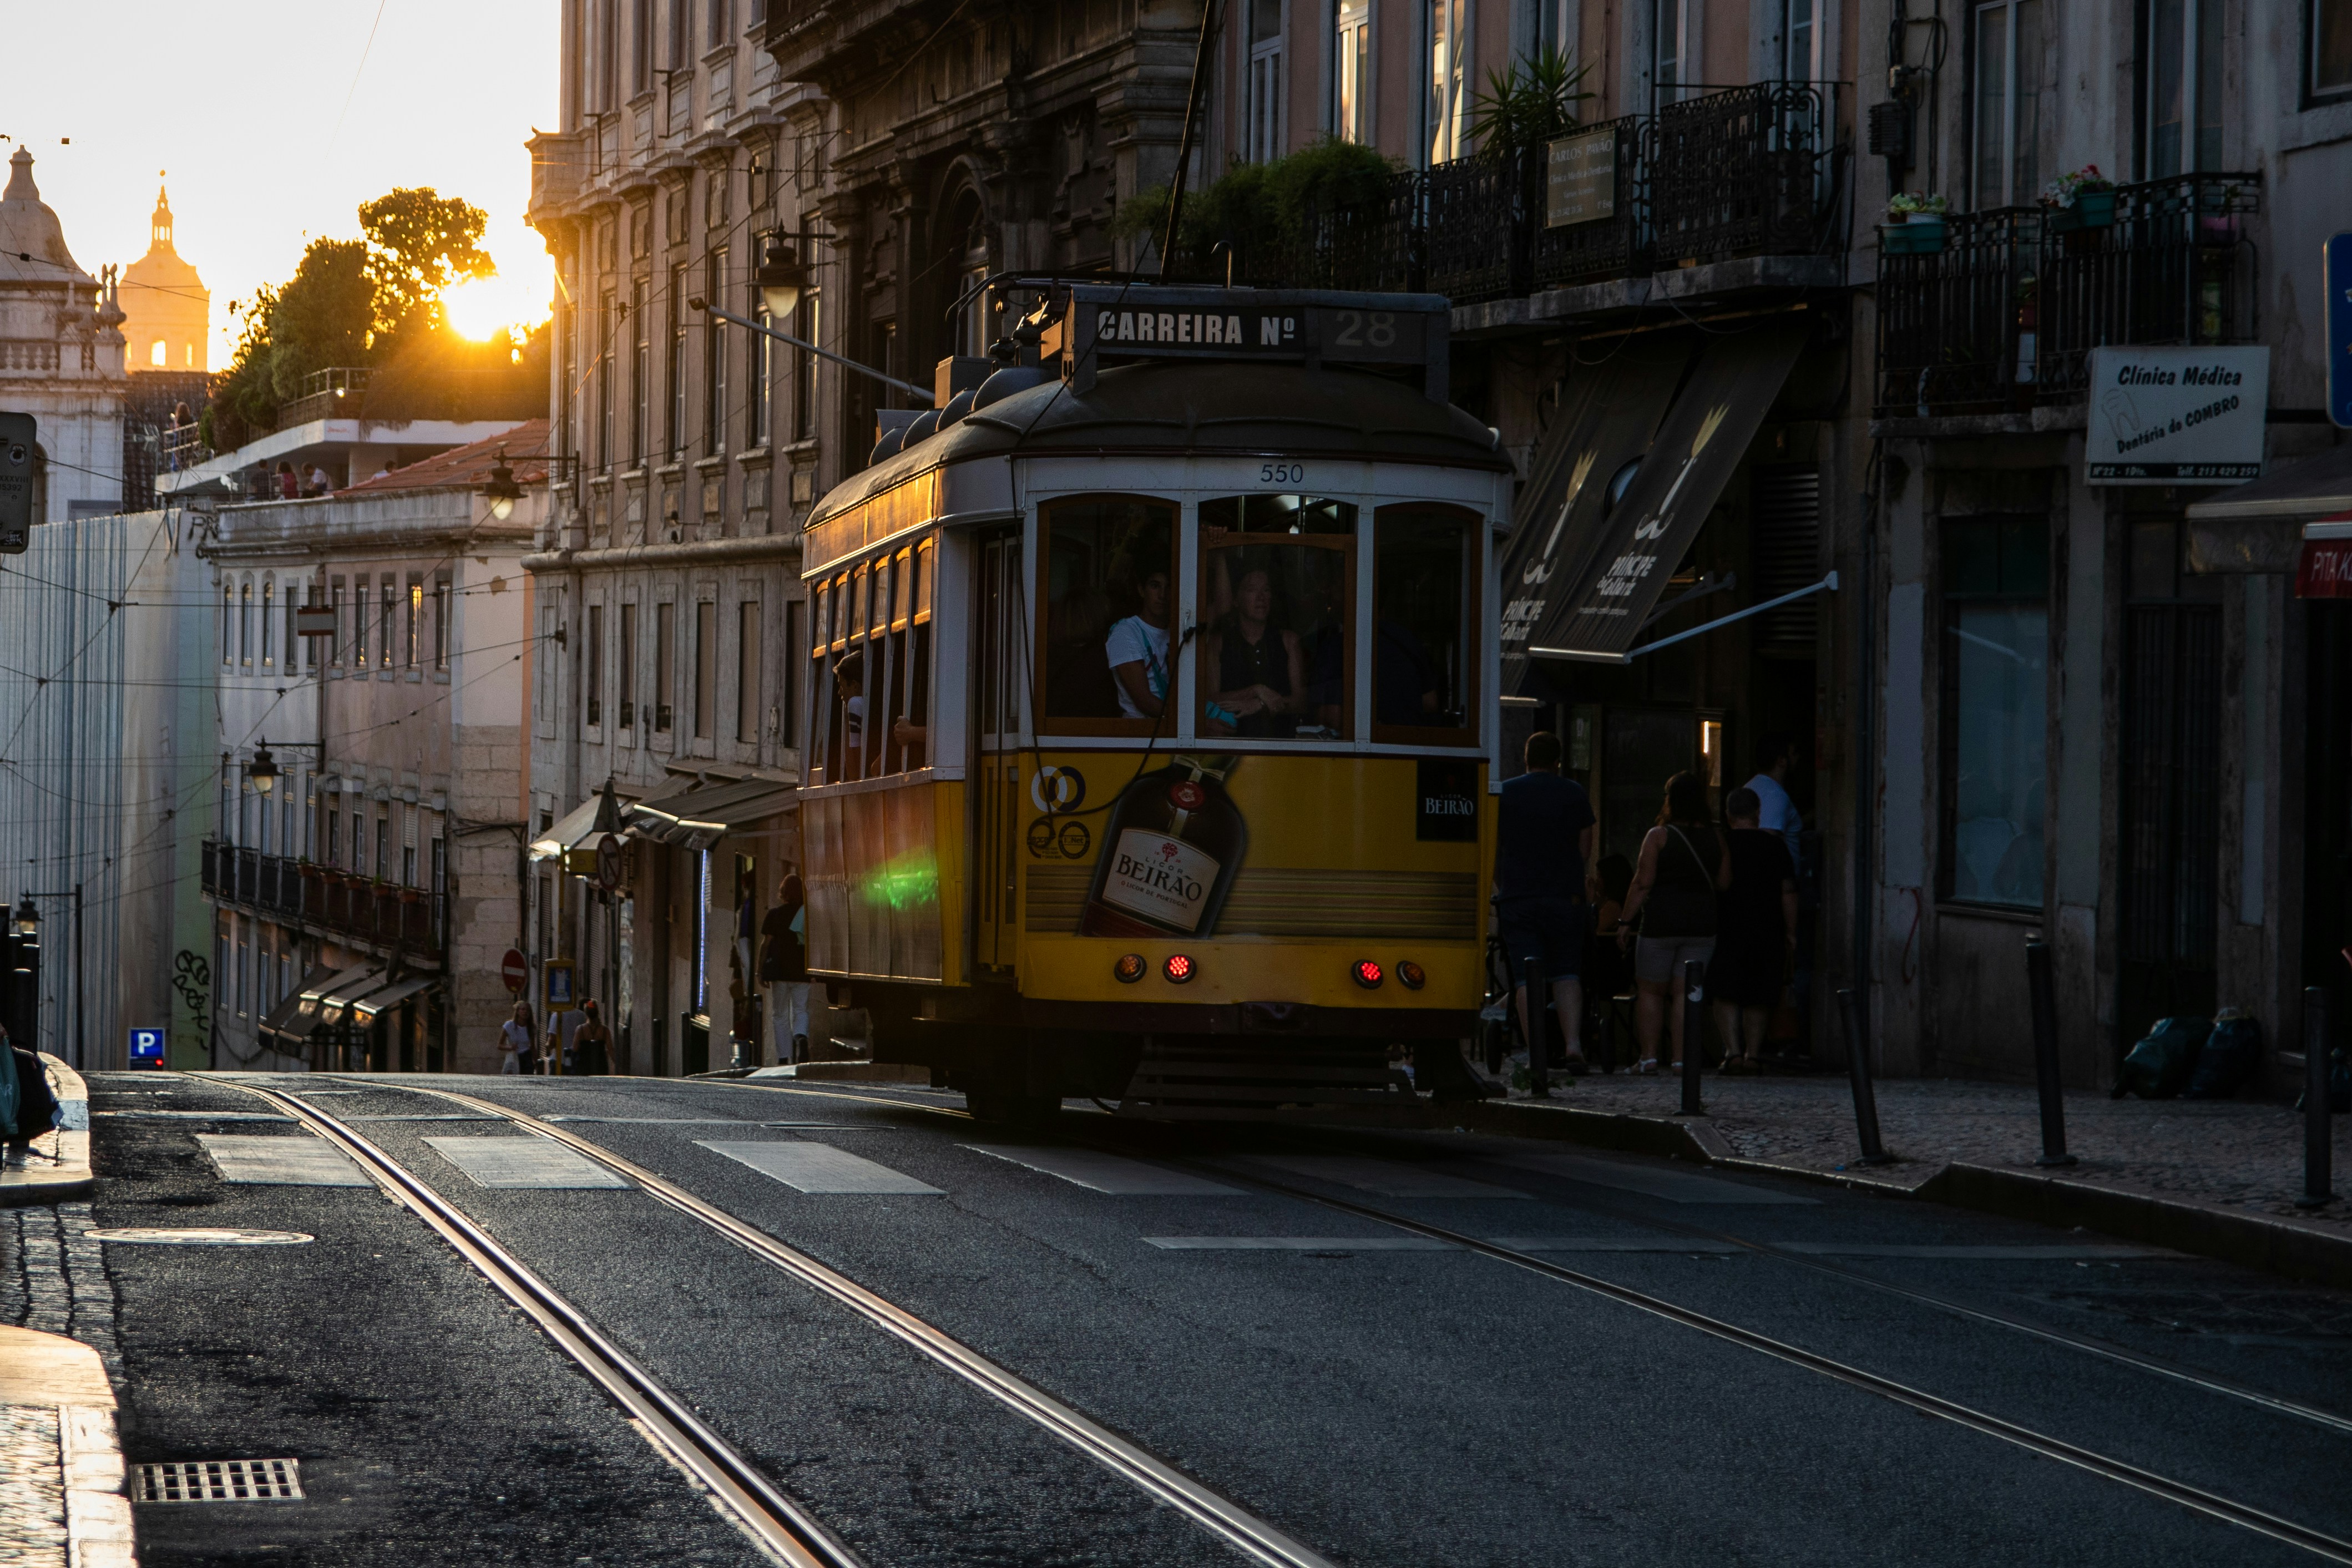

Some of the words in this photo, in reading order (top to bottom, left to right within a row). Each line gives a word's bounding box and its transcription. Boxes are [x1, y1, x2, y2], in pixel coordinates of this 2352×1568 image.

[1549, 146, 1581, 164] CARLOS
[1097, 310, 1243, 345] CARREIRA
[1261, 316, 1295, 346] Nº
[1335, 311, 1397, 348] 28
[2117, 365, 2176, 385] Clínica
[2182, 365, 2242, 386] Médica
[2116, 426, 2165, 454] Dentária
[2184, 395, 2239, 427] COMBRO
[1261, 464, 1304, 484] 550
[2197, 467, 2215, 476] 213
[2218, 467, 2237, 476] 429
[2239, 467, 2258, 476] 259
[1606, 551, 1658, 577] PRÍNCIPE
[2310, 552, 2338, 581] PITA
[1501, 595, 1547, 621] PRÍNCIPE
[1425, 797, 1474, 816] BEIRÃO
[1115, 853, 1202, 902] BEIRÃO
[1145, 856, 1184, 874] LICOR
[1126, 881, 1145, 894] LICOR
[1145, 888, 1155, 897] DE
[1156, 893, 1189, 910] PORTUGAL
[138, 1031, 156, 1055] P
